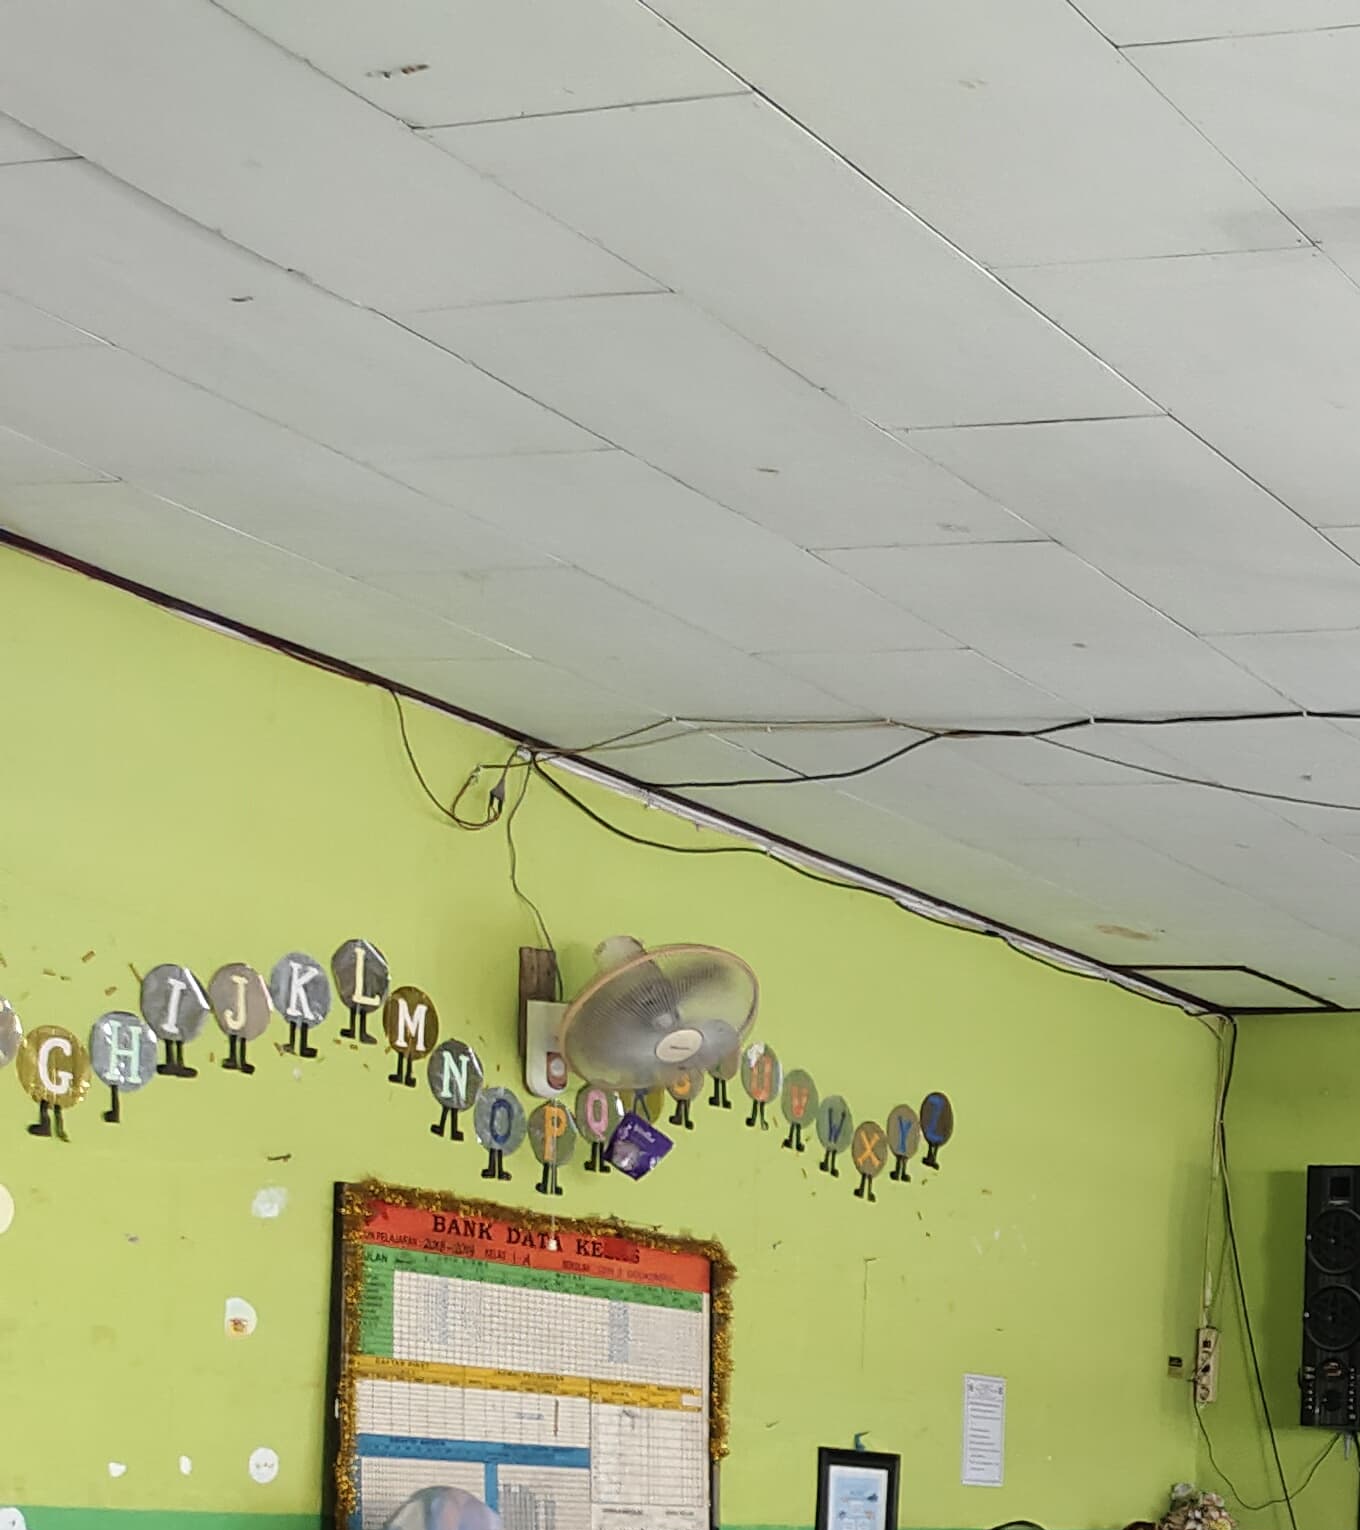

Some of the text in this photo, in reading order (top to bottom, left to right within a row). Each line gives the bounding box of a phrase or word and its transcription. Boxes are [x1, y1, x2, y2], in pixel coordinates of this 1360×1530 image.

[38, 1036, 74, 1096] G
[102, 1019, 144, 1084] H
[161, 978, 187, 1034] I
[223, 974, 249, 1031] J
[286, 960, 320, 1020] K
[352, 947, 381, 1006] L
[395, 998, 428, 1052] M
[440, 1050, 470, 1100] N
[489, 1098, 514, 1145] O
[543, 1104, 568, 1161] P
[855, 1131, 881, 1168] X
[896, 1114, 913, 1154] Y
[926, 1093, 944, 1145] Z
[432, 1213, 640, 1265] BANK DATA KES
